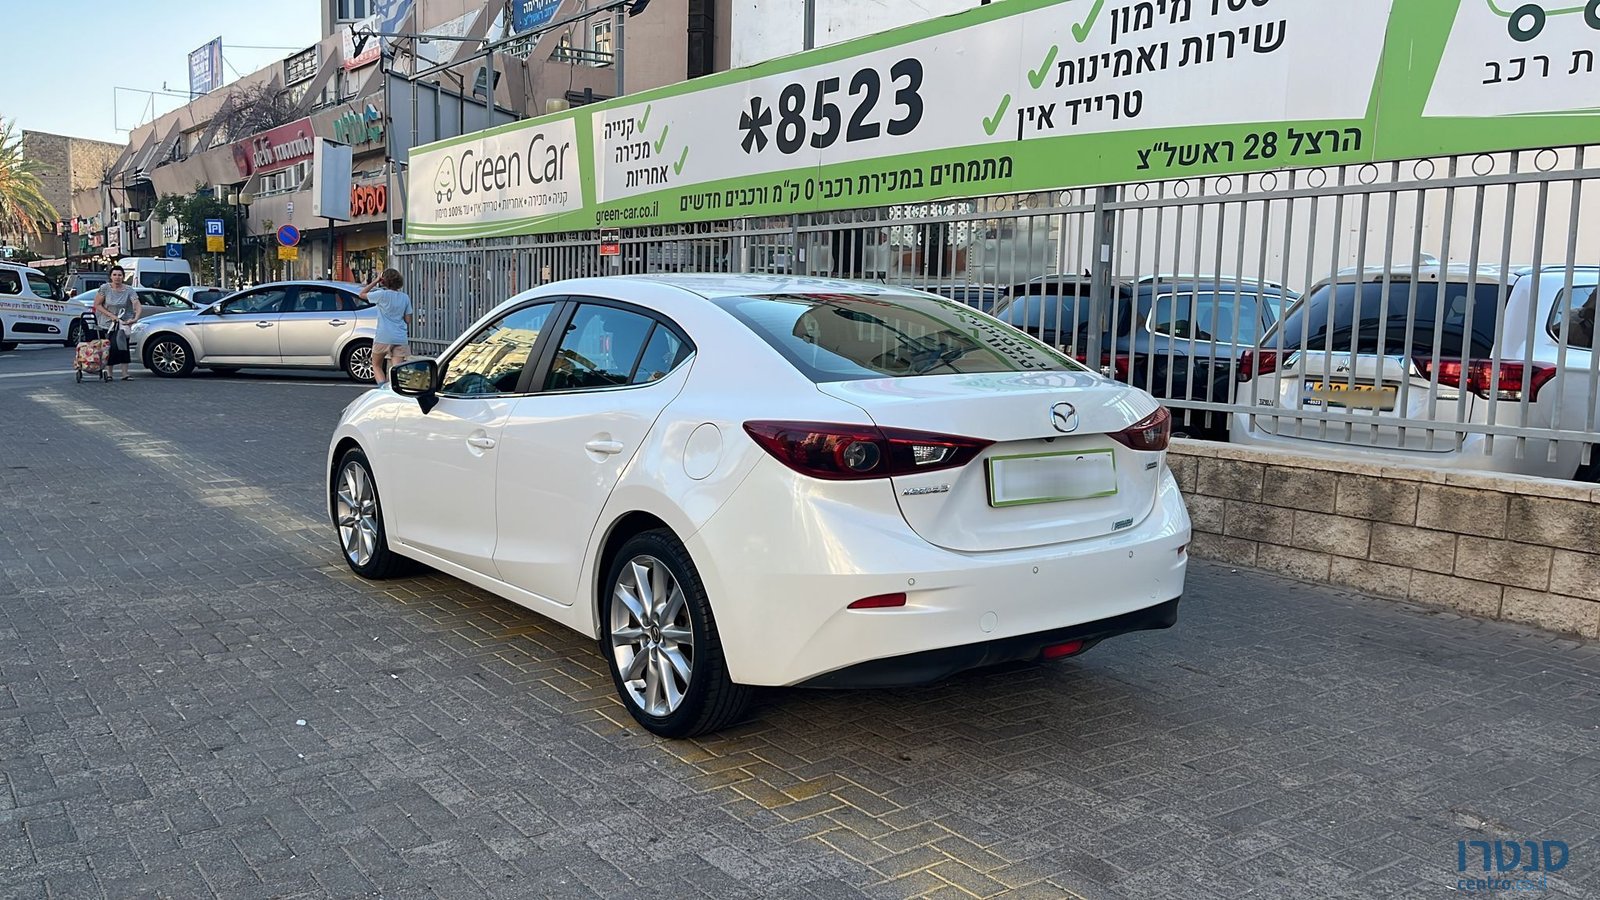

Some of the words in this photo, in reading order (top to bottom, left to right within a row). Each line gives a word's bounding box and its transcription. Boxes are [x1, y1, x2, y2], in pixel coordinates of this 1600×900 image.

[1111, 0, 1191, 45] מימון
[1178, 20, 1286, 67] שירות
[1055, 42, 1169, 87] ואמינות
[1483, 55, 1549, 84] רכב
[1017, 103, 1056, 141] אין
[1065, 90, 1143, 125] טרייד
[604, 118, 634, 140] קנייה
[1288, 128, 1361, 156] הרצל
[616, 141, 650, 163] מכירה
[1136, 141, 1234, 170] ראשל"צ
[1243, 131, 1277, 160] 28
[459, 149, 521, 195] Green
[527, 133, 570, 184] Car
[626, 165, 668, 188] אחריות
[930, 156, 1012, 186] מתמחים
[819, 177, 852, 199] רכבי
[858, 168, 923, 194] במכירת
[680, 192, 721, 211] חדשים
[725, 187, 768, 207] ורכבים
[596, 201, 658, 225] green-car.co.il
